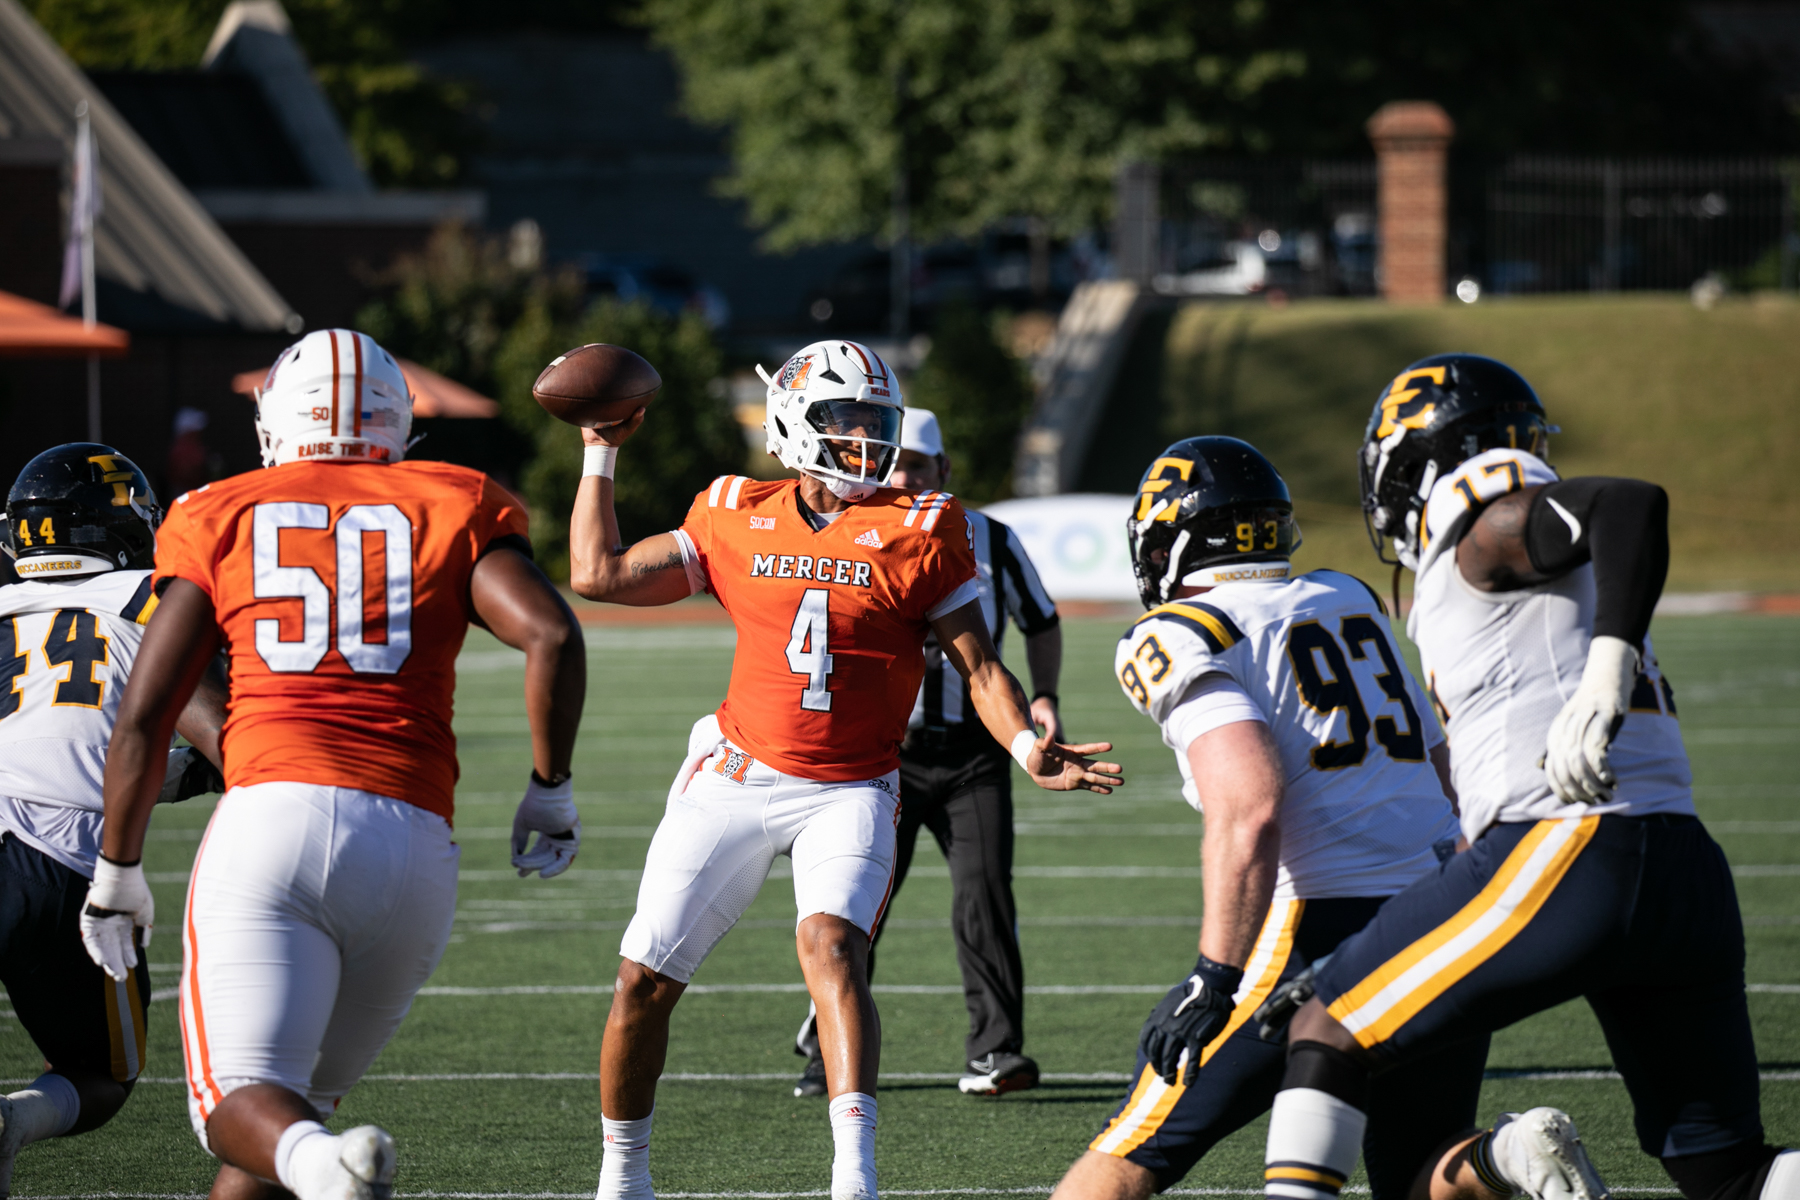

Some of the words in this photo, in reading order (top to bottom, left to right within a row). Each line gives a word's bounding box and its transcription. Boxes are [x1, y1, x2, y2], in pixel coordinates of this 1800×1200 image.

[312, 407, 329, 420] 50
[298, 442, 334, 458] RAISE
[340, 443, 365, 457] THE
[1452, 458, 1525, 511] 17
[19, 517, 56, 546] 44
[854, 537, 883, 549] adidas
[1236, 521, 1278, 552] 93
[253, 501, 412, 675] 50
[750, 553, 872, 588] MERCER
[784, 588, 834, 713] 4
[1119, 633, 1172, 708] 93
[1286, 613, 1427, 771] 93
